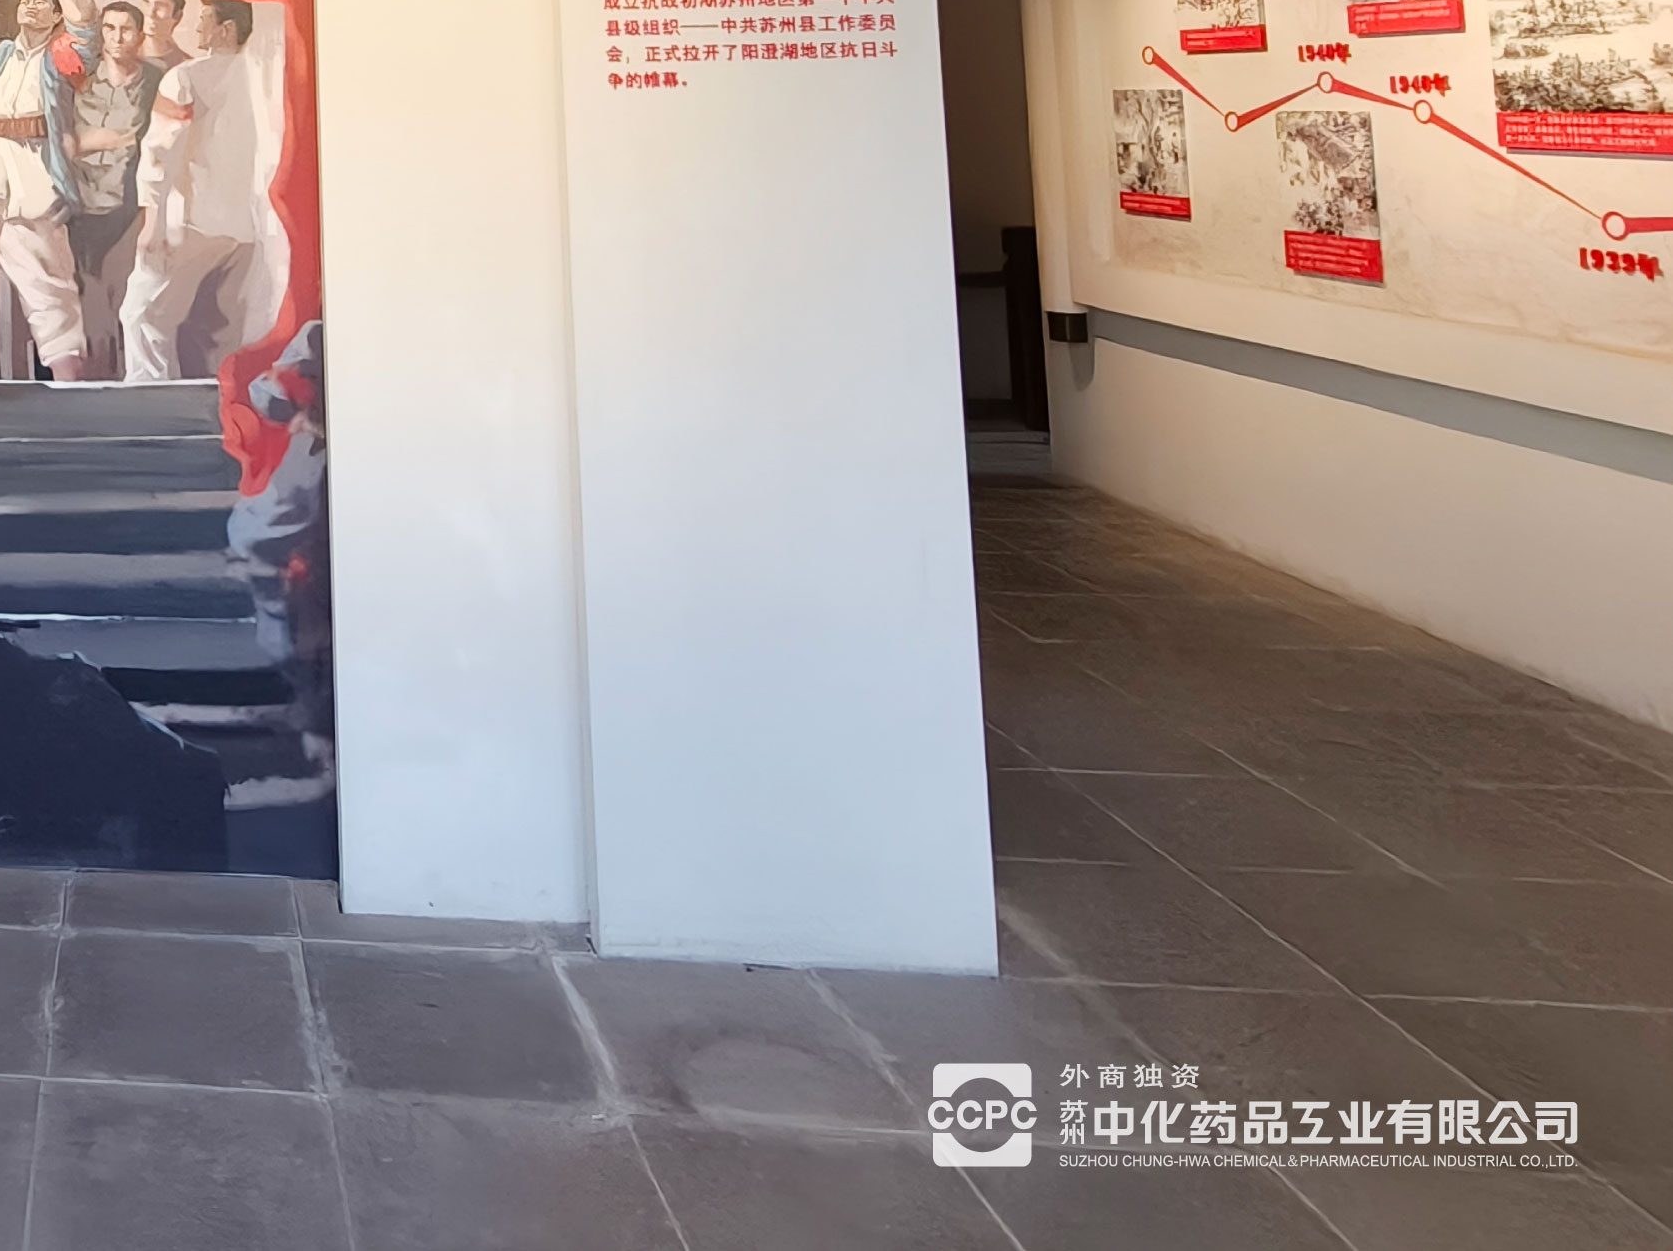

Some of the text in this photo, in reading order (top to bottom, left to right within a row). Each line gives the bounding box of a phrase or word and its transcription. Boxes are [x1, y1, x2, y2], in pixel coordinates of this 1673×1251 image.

[605, 14, 896, 37] 县级组织——中共苏州县工作委员
[606, 41, 898, 65] 会，正式拉开了阳澄湖地区抗日斗
[608, 71, 688, 90] 争的帷幕。
